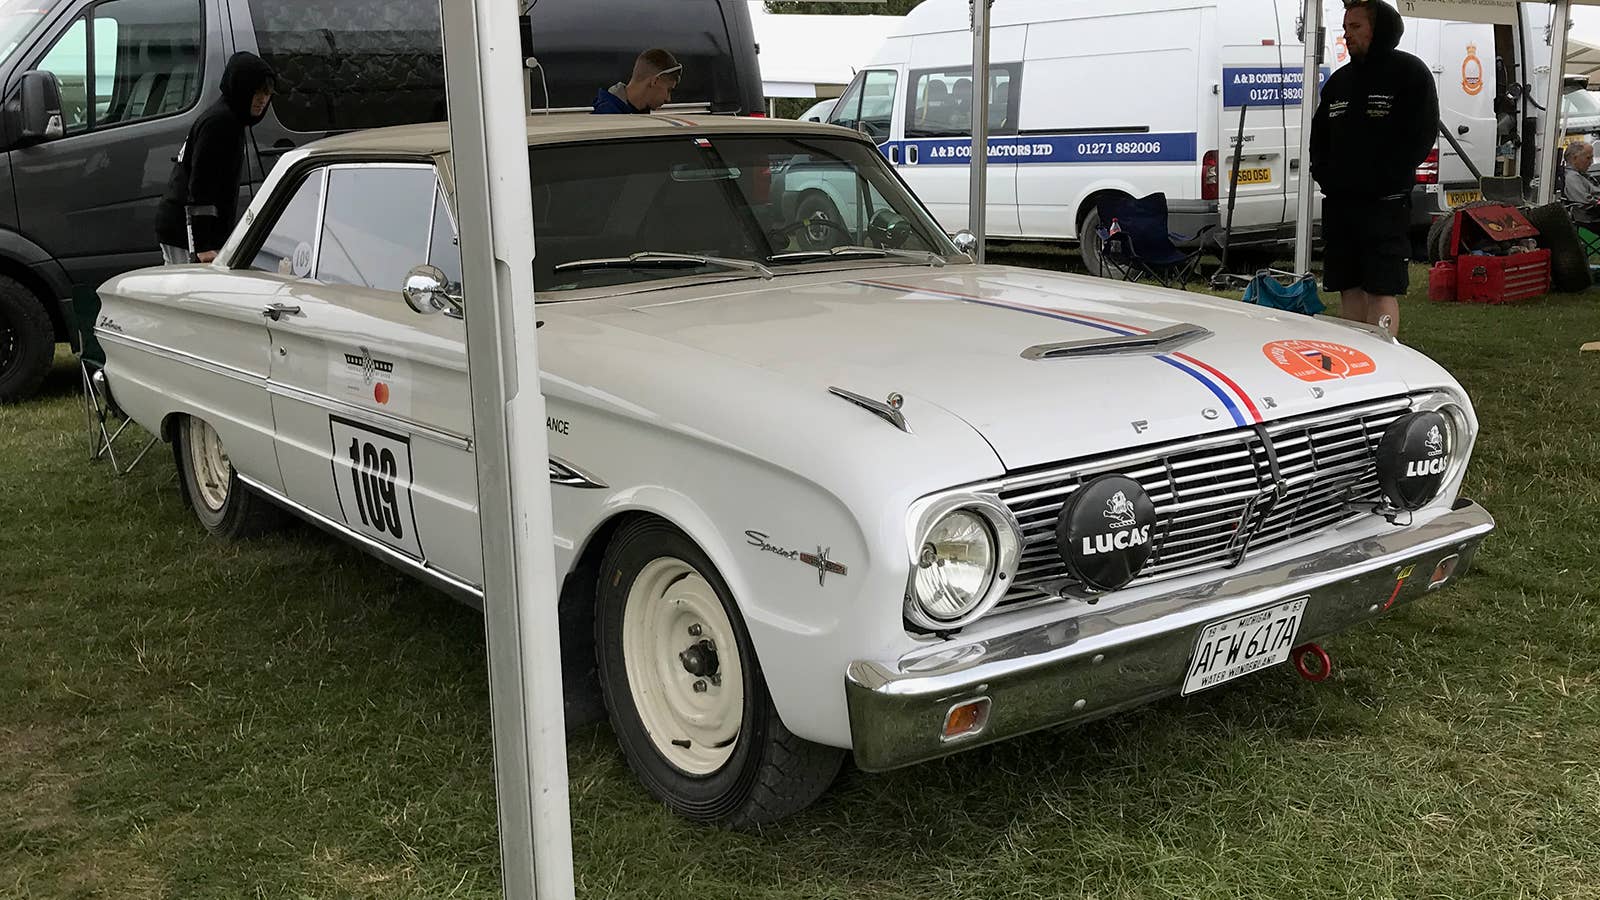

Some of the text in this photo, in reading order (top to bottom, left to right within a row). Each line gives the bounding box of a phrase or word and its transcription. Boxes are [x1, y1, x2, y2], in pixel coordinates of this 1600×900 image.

[1233, 74, 1241, 84] A
[1241, 73, 1249, 83] &
[1249, 73, 1255, 83] B
[1250, 88, 1280, 100] 01271
[930, 143, 1053, 157] A & B CORACTORS LTD
[1078, 142, 1161, 155] 01271 882006
[1235, 170, 1252, 182] S60
[1131, 386, 1325, 434] FORD
[1406, 455, 1448, 477] LUCAS
[349, 437, 403, 540] 109
[744, 530, 799, 560] Sprint
[1082, 524, 1151, 555] LUCAS
[1238, 611, 1273, 628] MICHIGAN
[1192, 615, 1297, 677] AFW 617A
[1201, 654, 1277, 687] WATER WONDERLAND
